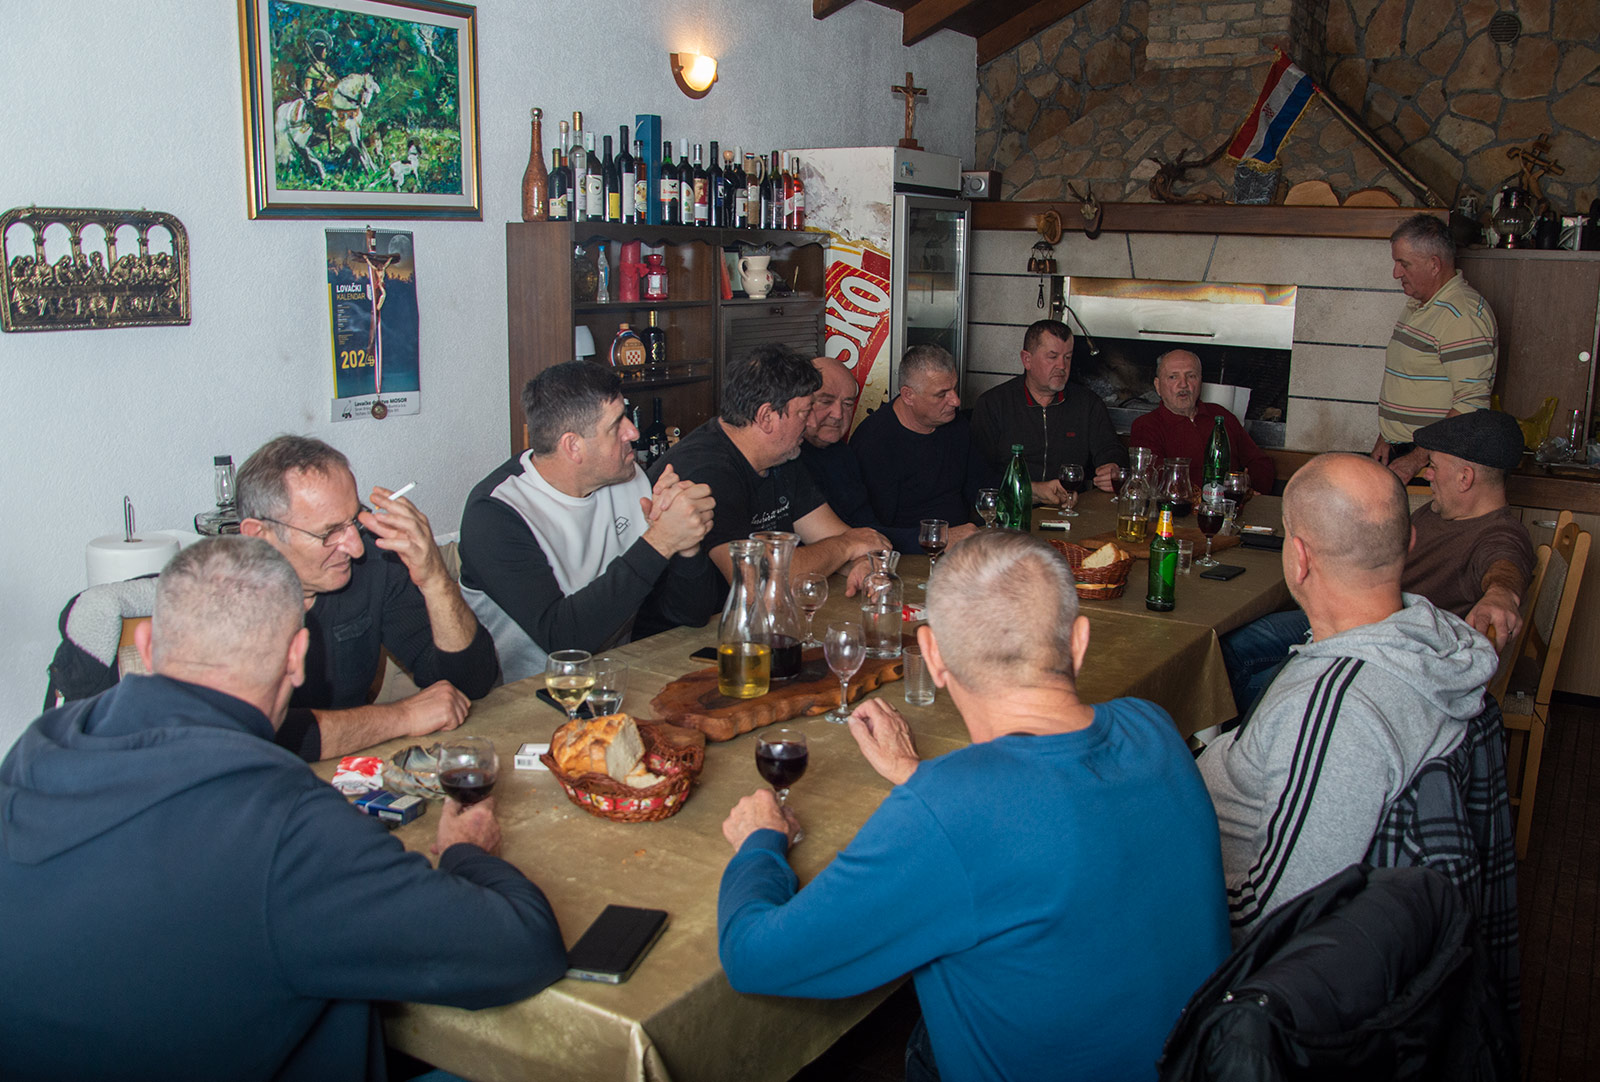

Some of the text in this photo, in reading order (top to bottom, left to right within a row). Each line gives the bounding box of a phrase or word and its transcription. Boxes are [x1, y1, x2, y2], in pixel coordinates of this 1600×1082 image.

[336, 283, 362, 293] LOVAČKI
[336, 292, 366, 300] KALENDAR
[825, 275, 890, 371] SKO
